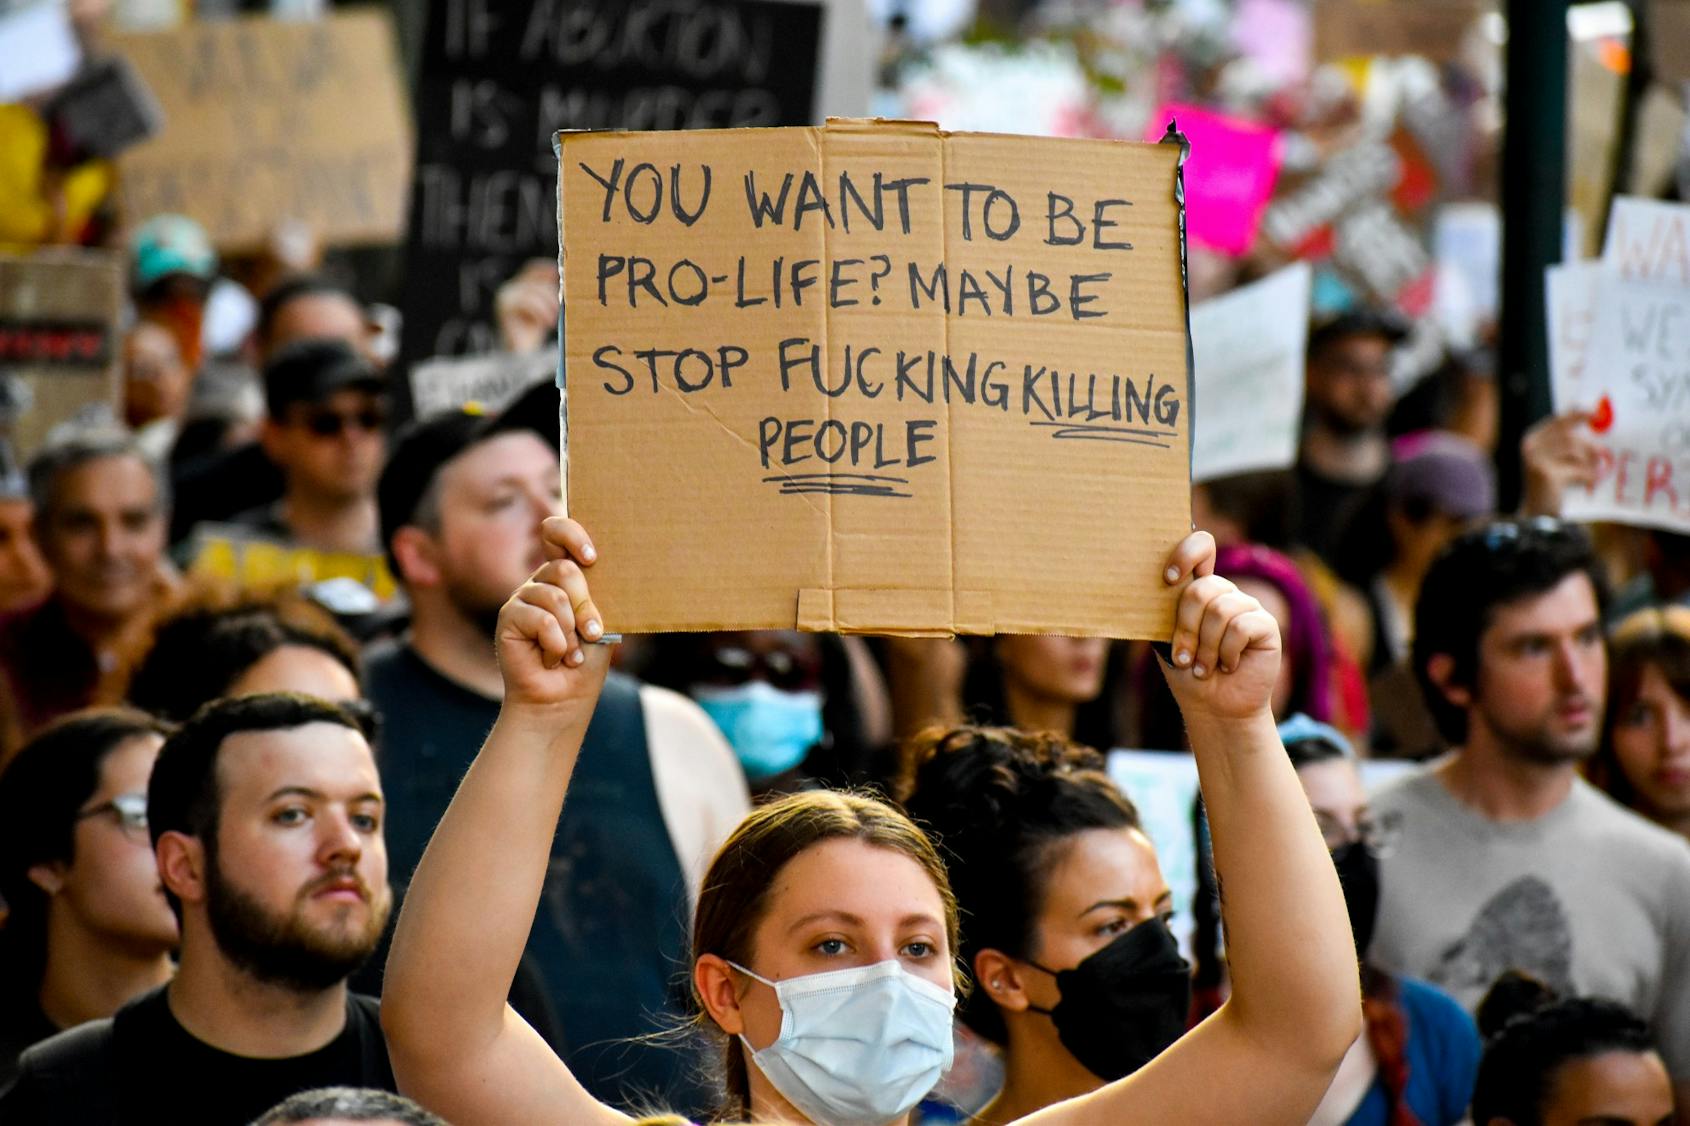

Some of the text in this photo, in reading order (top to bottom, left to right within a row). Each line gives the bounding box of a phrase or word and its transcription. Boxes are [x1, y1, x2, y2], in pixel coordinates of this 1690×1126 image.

[578, 157, 1134, 251] YOU WANT TO BE
[596, 253, 1113, 321] PRO-LIFE? MAYBE
[592, 344, 749, 396] STOP
[778, 337, 1009, 412] FUCKING
[1022, 363, 1181, 429] KILLING
[758, 415, 939, 470] PEOPLE
